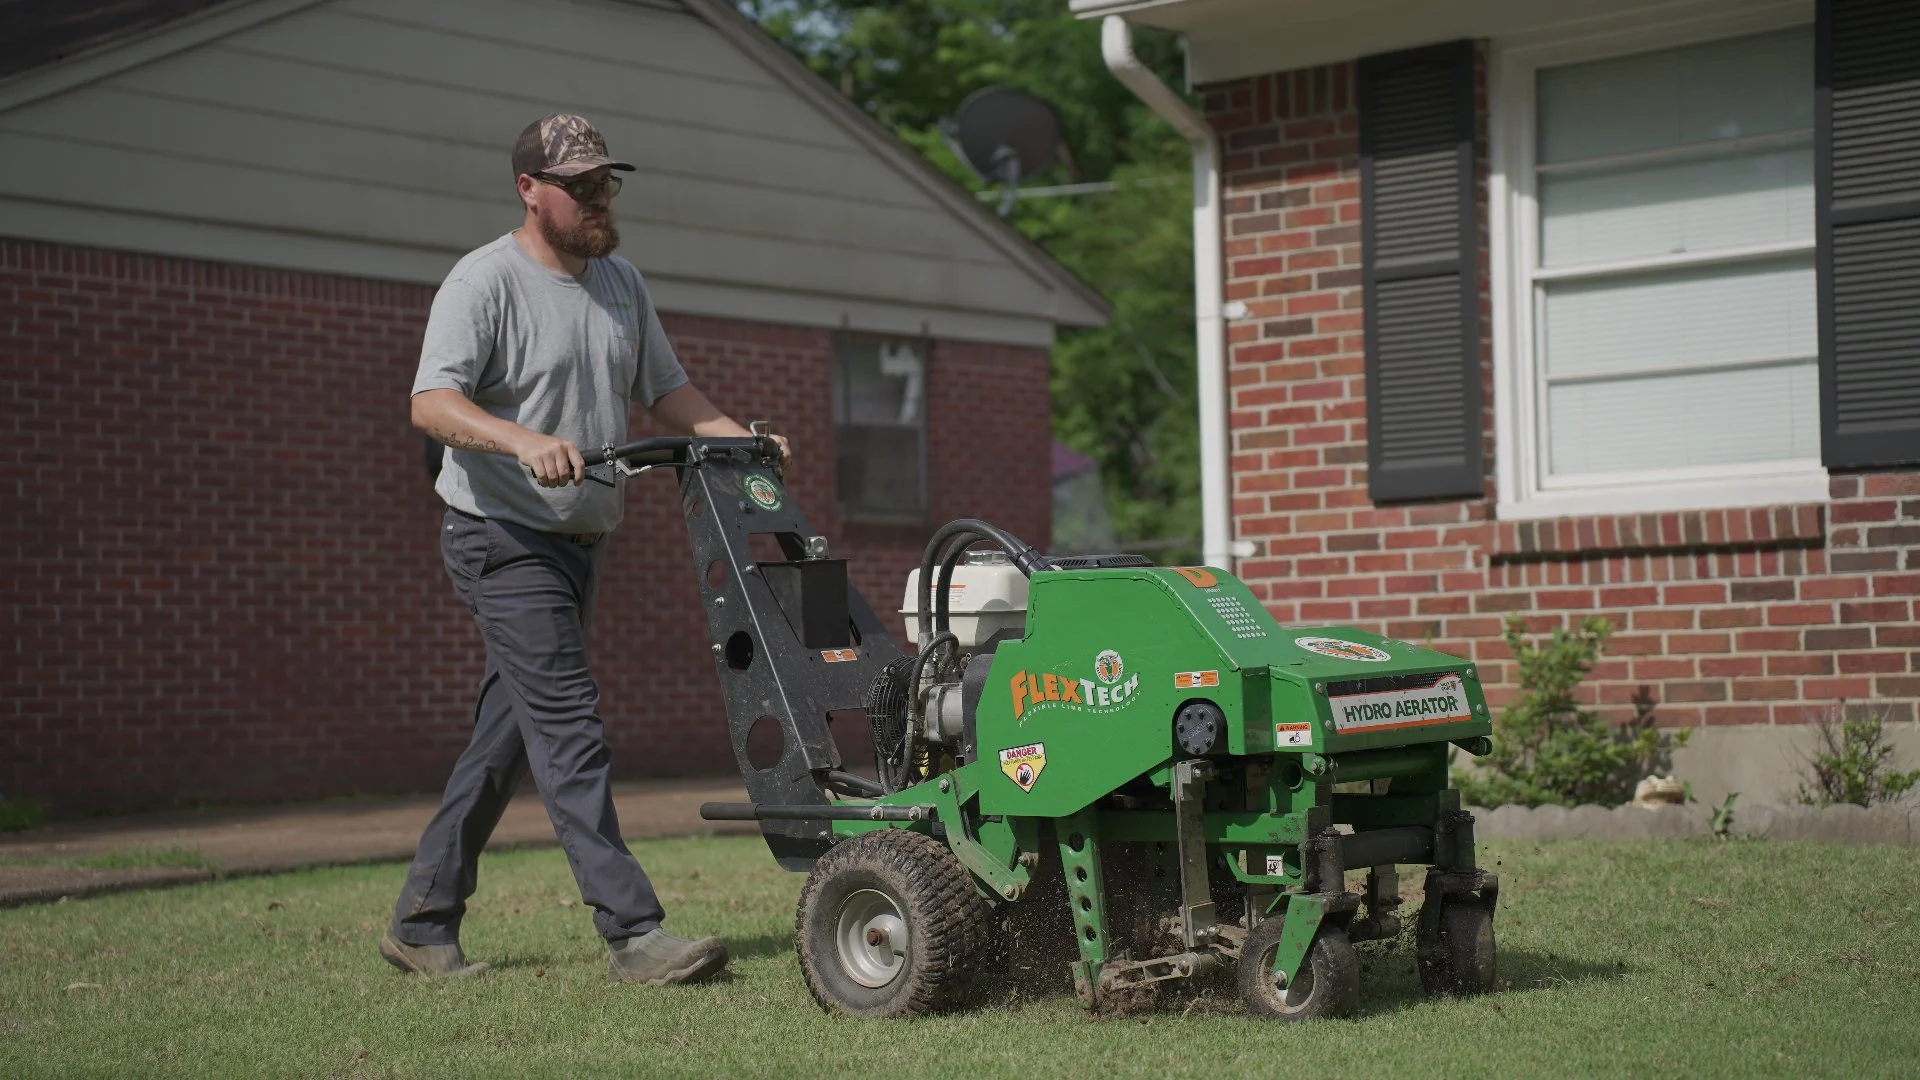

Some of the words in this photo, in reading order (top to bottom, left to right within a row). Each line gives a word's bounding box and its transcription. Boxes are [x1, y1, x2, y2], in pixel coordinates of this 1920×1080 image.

[1010, 670, 1140, 721] FLEXTECH
[1343, 703, 1392, 722] HYDRO
[1395, 696, 1458, 718] AERATOR
[1006, 746, 1038, 760] DANGER
